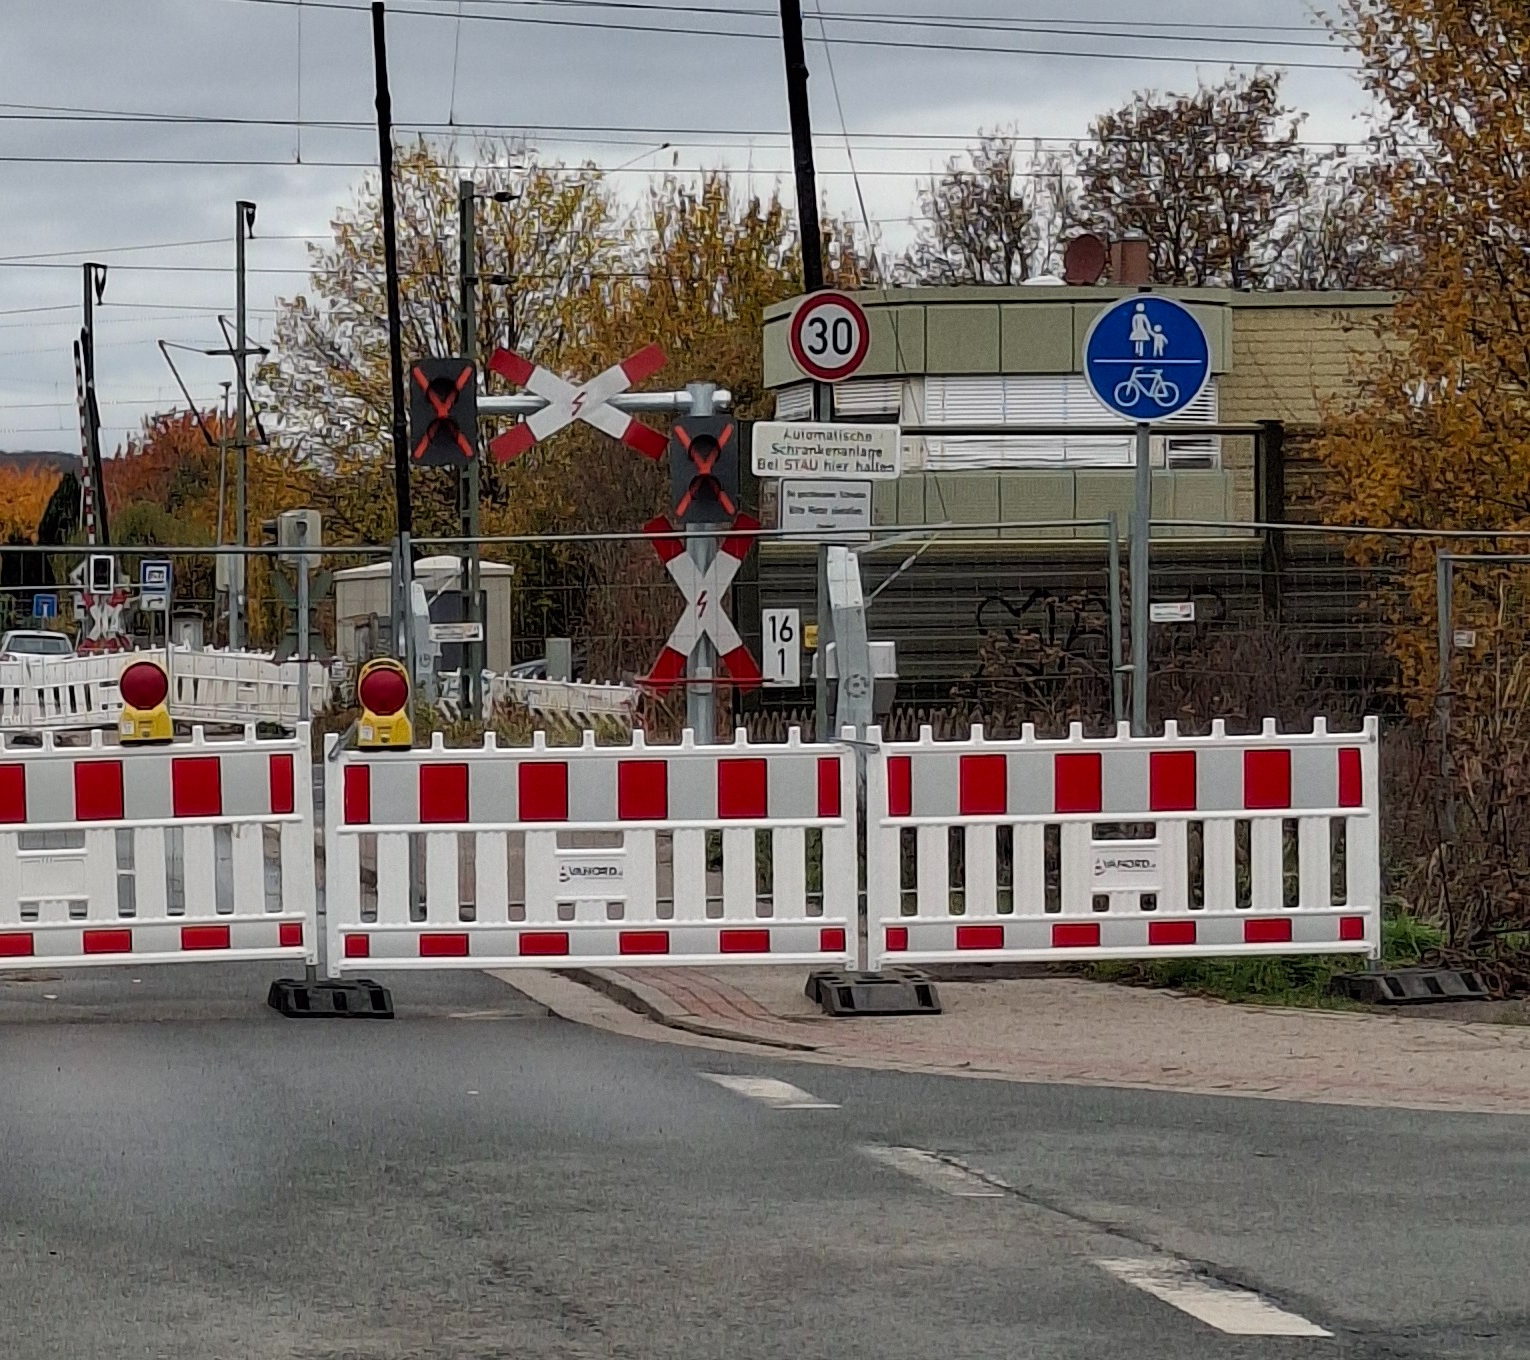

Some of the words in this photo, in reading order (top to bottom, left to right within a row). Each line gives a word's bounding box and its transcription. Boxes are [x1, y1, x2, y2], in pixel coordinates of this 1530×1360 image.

[808, 317, 853, 355] 30
[783, 427, 873, 442] Automatische
[770, 443, 883, 460] Schrankenanlage
[757, 457, 778, 471] Bei
[784, 458, 819, 471] STAU
[823, 459, 849, 472] hier
[769, 614, 793, 643] 16
[777, 647, 785, 677] 1
